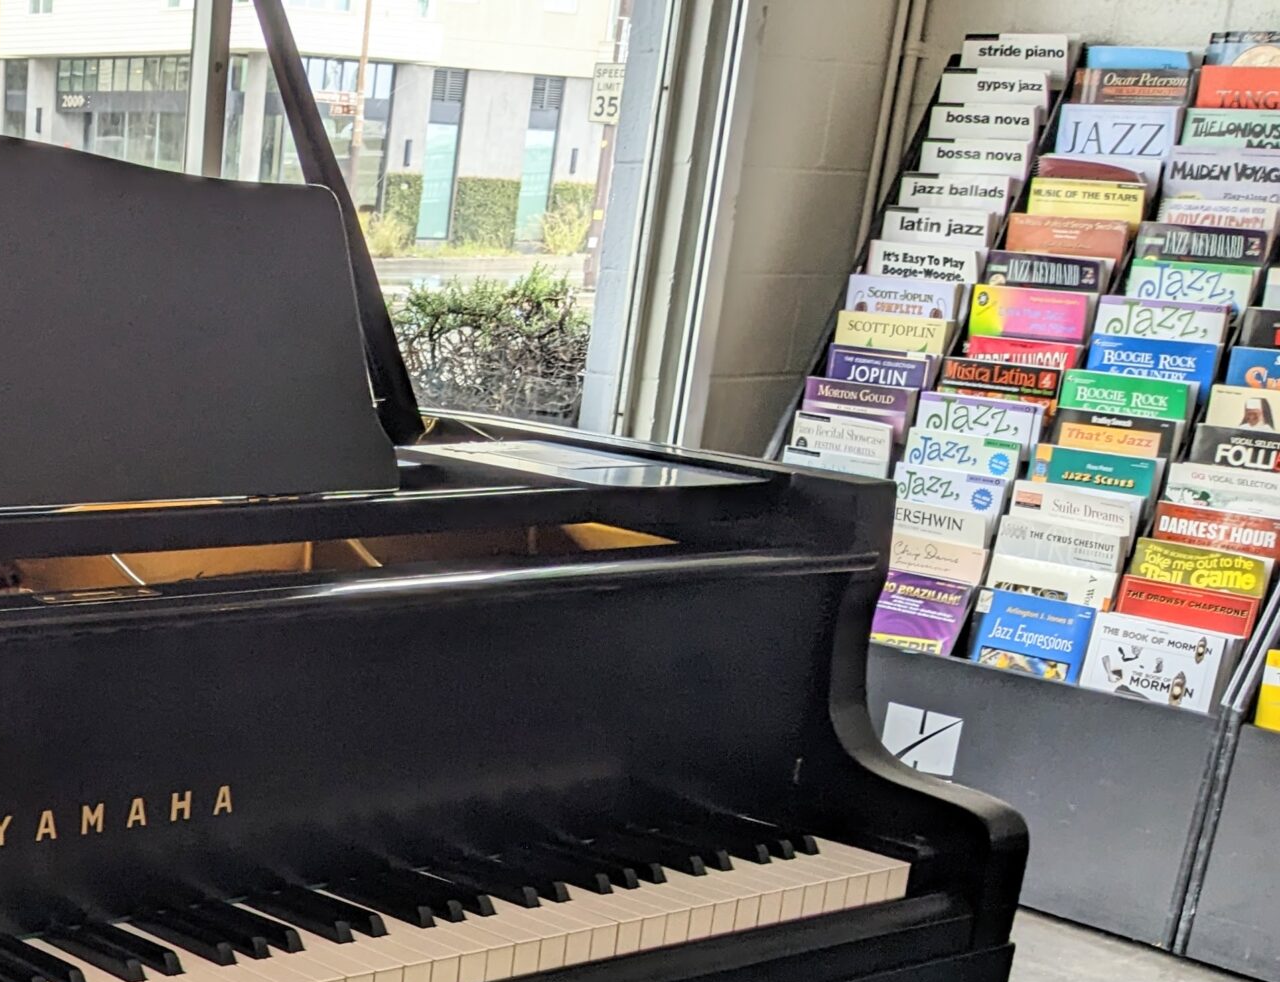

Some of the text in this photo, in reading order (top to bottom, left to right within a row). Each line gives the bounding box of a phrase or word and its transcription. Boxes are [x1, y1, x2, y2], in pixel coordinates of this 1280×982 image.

[978, 45, 1065, 59] stride piano
[596, 82, 621, 91] LIMIT
[977, 80, 1043, 92] gypsy jazz
[1103, 72, 1189, 87] Oscar Peterson
[594, 96, 618, 117] 35
[946, 112, 1030, 125] bossa nova
[1065, 120, 1166, 157] JAZZ
[937, 147, 1022, 161] bossa nova
[910, 182, 1005, 198] jazz ballads
[1033, 188, 1138, 202] MUSIC OF THE STARS
[899, 216, 984, 237] latin jazz
[882, 251, 965, 270] It's Easy To Play
[848, 320, 937, 339] SCOTT JOPLIN
[847, 364, 908, 386] JOPLIN
[944, 360, 991, 383] Música
[993, 365, 1037, 388] Latina
[1067, 427, 1153, 448] That's Jazz
[895, 507, 965, 531] ERSHWIN
[1051, 498, 1125, 523] Suite Dreams
[1030, 530, 1116, 553] THE CYRUS CHESTNUT
[1158, 515, 1230, 541] DARKEST
[1230, 526, 1277, 549] HOUR
[1144, 549, 1171, 569] Take
[1172, 561, 1195, 571] me
[1196, 559, 1218, 570] out
[1219, 557, 1233, 568] to
[1234, 556, 1255, 571] the
[1140, 562, 1257, 591] Ball Game
[988, 617, 1074, 653] Jazz Expressions
[1103, 626, 1120, 636] THE
[1122, 630, 1149, 642] BOOK
[1151, 636, 1165, 645] OF
[1167, 640, 1213, 656] MORMN
[1129, 676, 1195, 699] MORMN
